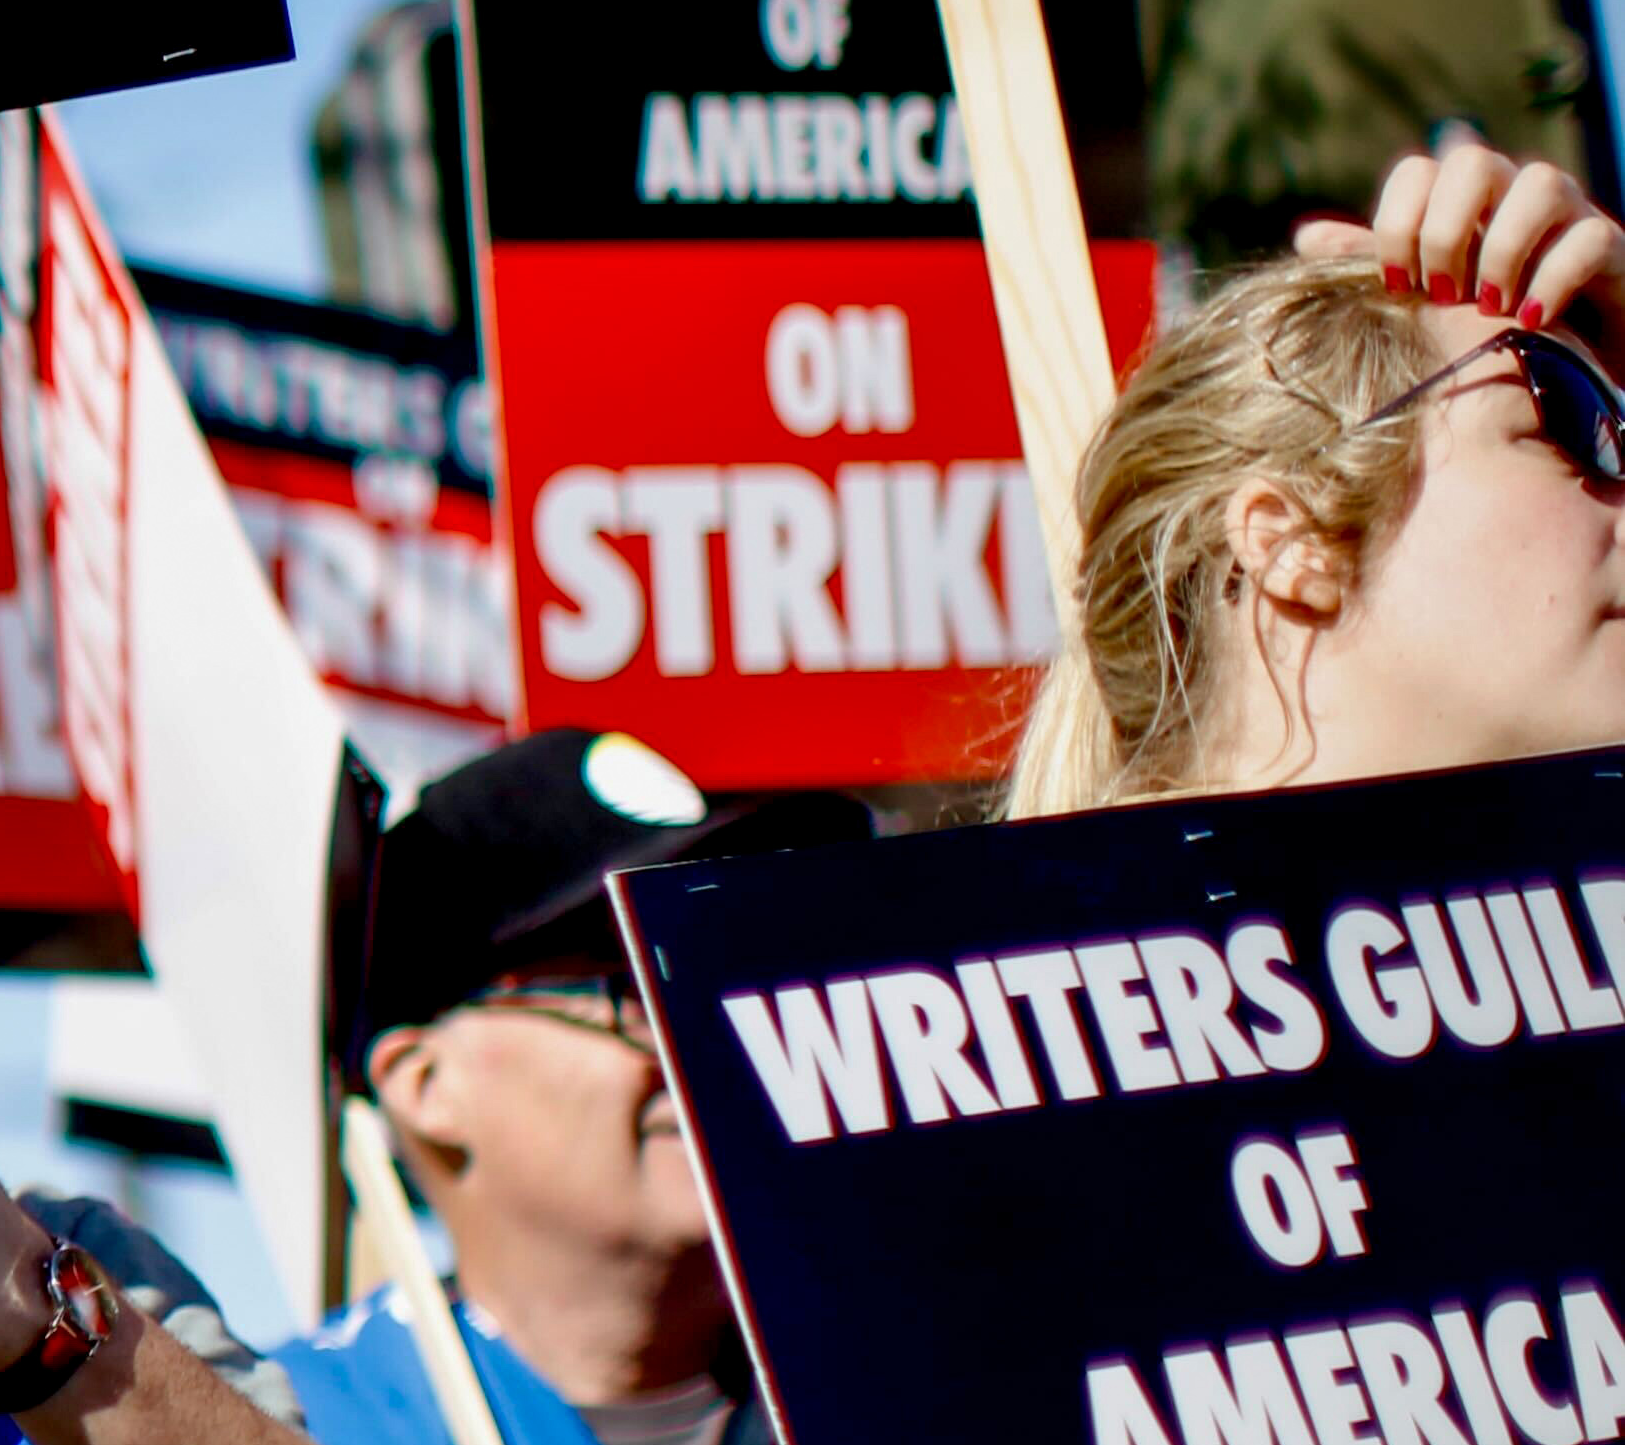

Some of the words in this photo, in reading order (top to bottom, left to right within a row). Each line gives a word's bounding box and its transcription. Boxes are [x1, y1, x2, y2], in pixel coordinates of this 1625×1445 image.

[765, 302, 915, 437] ON
[723, 924, 1324, 1143] WRITERS
[1230, 1129, 1371, 1269] OF
